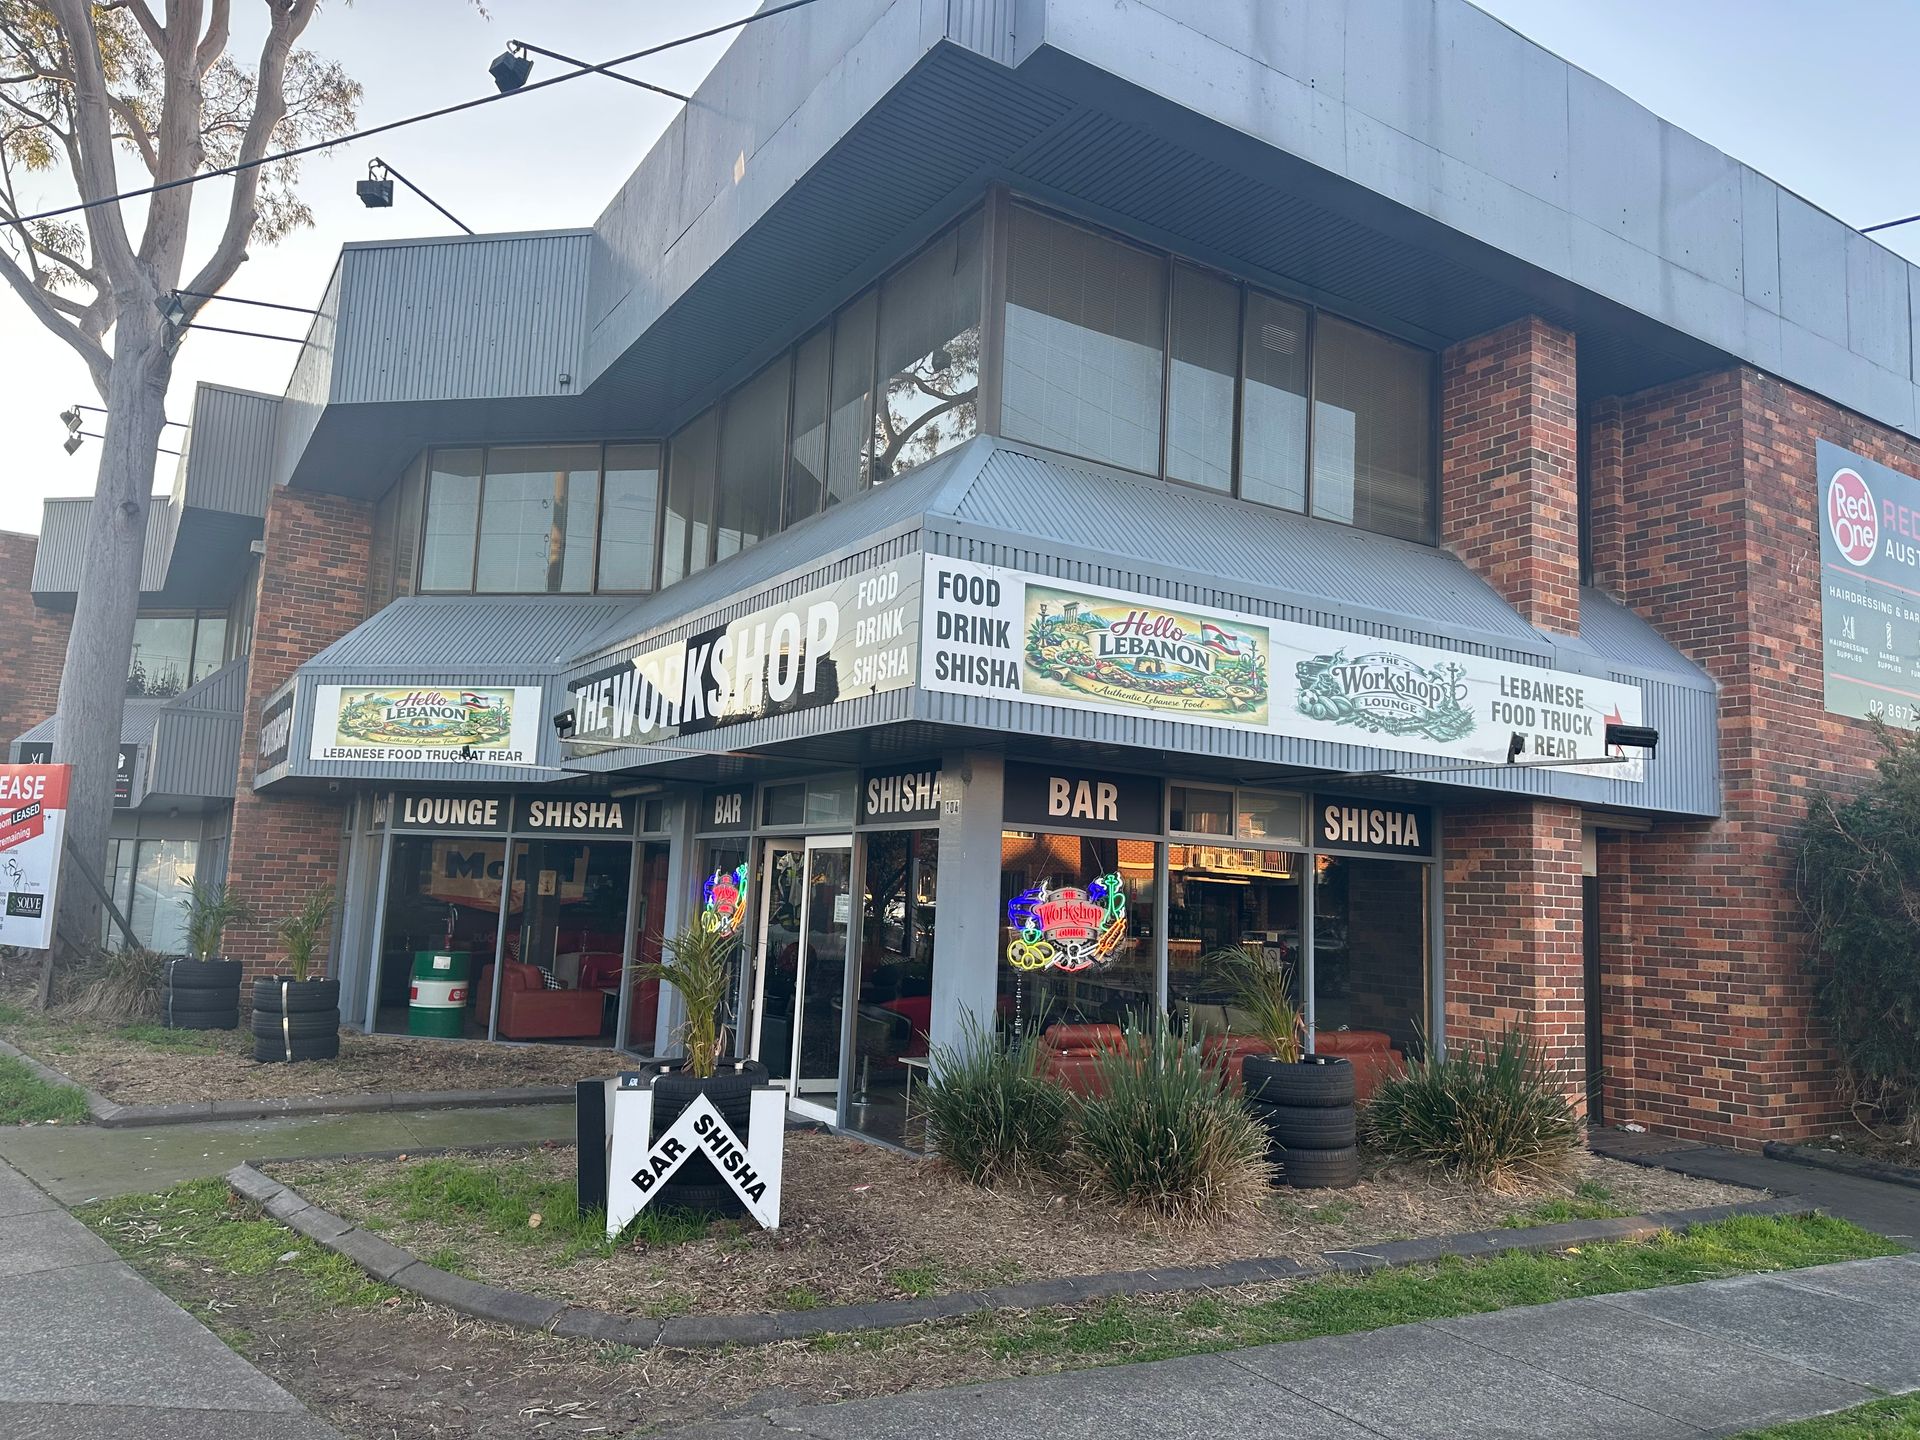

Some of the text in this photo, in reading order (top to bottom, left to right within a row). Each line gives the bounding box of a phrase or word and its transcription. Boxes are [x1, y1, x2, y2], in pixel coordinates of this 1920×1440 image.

[1835, 483, 1871, 521] Red
[1836, 518, 1874, 553] One
[857, 571, 899, 609] FOOD
[938, 571, 1000, 607] FOOD
[1829, 586, 1893, 615] HAIRDRESSING
[855, 606, 905, 648] DRINK
[937, 610, 1010, 650] DRINK
[1110, 611, 1187, 641] Hello
[852, 646, 909, 687] SHISHA
[1099, 633, 1210, 671] LEBANON
[1380, 656, 1400, 666] THE
[1836, 649, 1863, 663] SUPPLIES
[575, 600, 840, 740] THE WORKSHOP
[935, 650, 1020, 690] SHISHA
[1332, 664, 1441, 709] Workshop
[394, 691, 449, 708] Hello
[1094, 686, 1205, 708] Authentic Lebanese Food
[1364, 698, 1417, 713] LOUNGE
[1500, 675, 1584, 709] LEBANESE
[386, 706, 466, 721] LEBANON
[1491, 700, 1593, 736] FOOD TRUCK
[323, 747, 385, 760] LEBANESE
[388, 748, 422, 760] FOOD
[489, 750, 523, 762] REAR
[1534, 734, 1577, 760] REAR
[714, 793, 742, 825] BAR
[867, 770, 941, 815] SHISHA
[1048, 776, 1118, 822] BAR
[13, 803, 40, 824] LEASED
[404, 797, 499, 826] LOUNGE
[529, 800, 623, 829] SHISHA
[1324, 804, 1420, 847] SHISHA
[17, 896, 42, 910] SOLVE
[1037, 900, 1102, 928] Workshop
[631, 1137, 687, 1193] BAR
[693, 1114, 767, 1204] SHISHA
